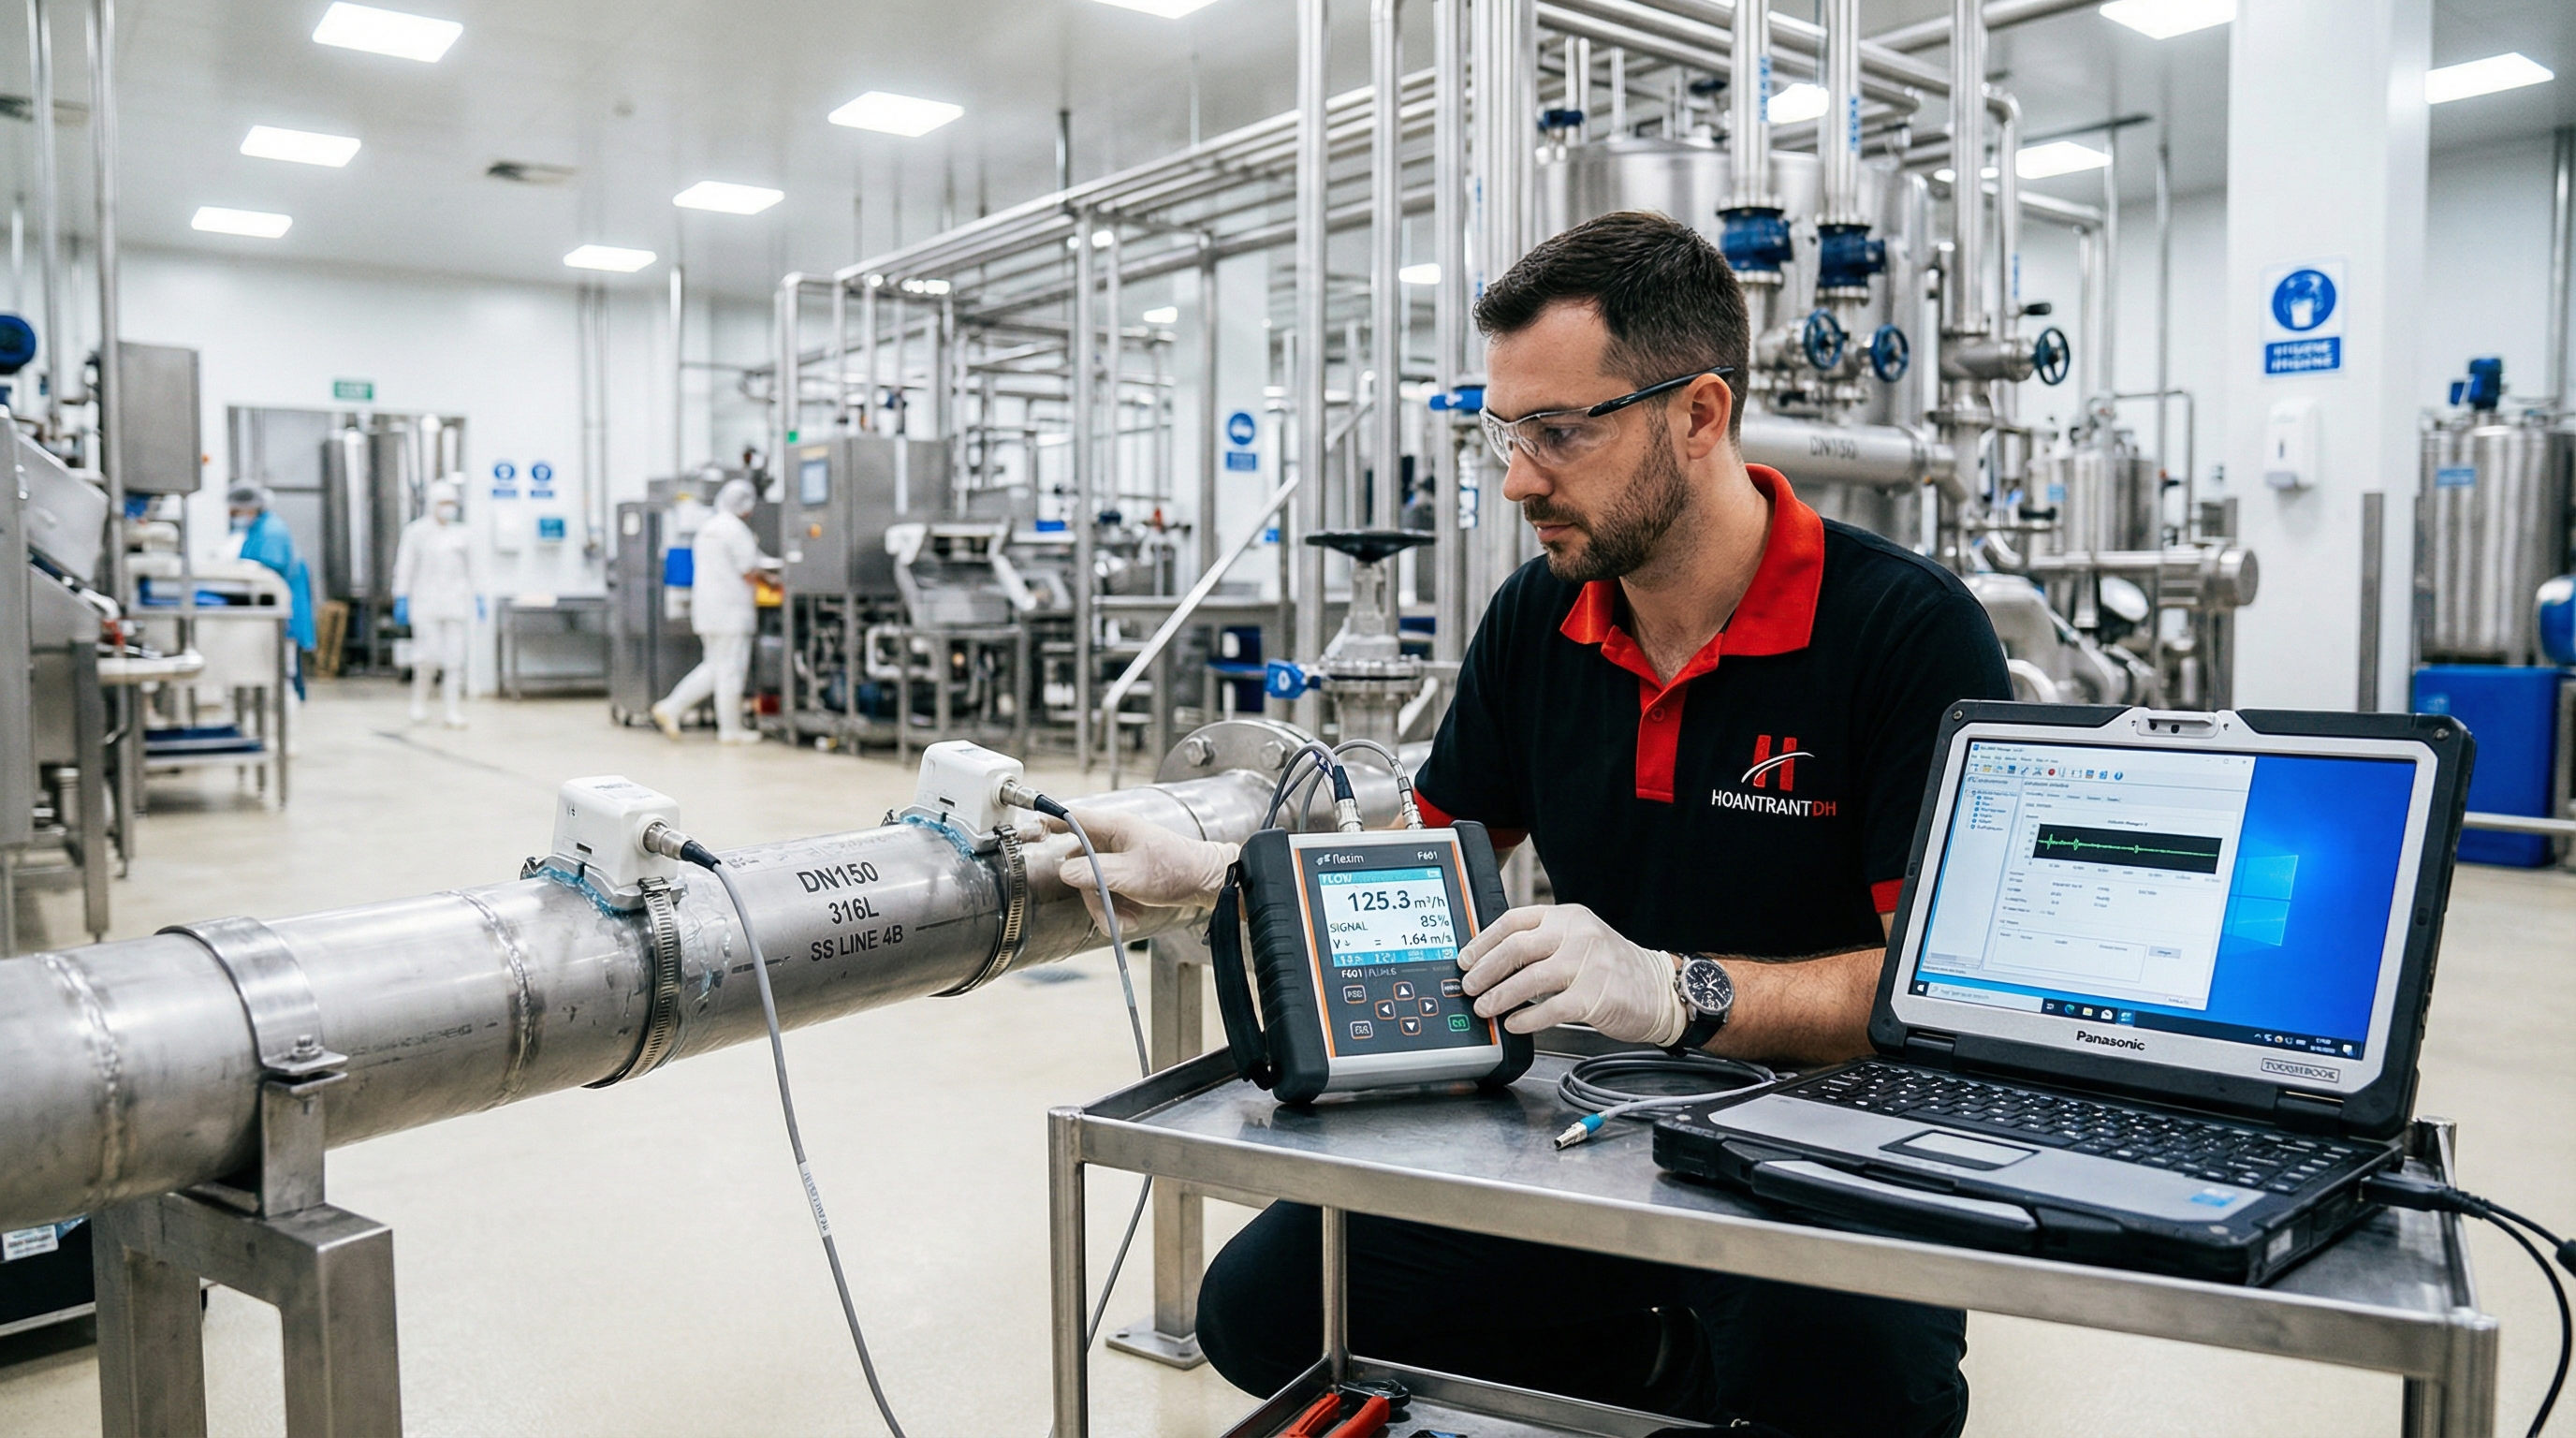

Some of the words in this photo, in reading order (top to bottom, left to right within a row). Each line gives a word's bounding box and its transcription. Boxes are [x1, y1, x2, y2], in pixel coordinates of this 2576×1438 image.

[1711, 789, 1837, 816] HOANTRANTDH
[1417, 851, 1438, 860] F601
[796, 861, 879, 893] DN150
[1322, 873, 1353, 884] FLOW
[828, 896, 880, 925] 316L
[1348, 890, 1411, 912] 125.3
[1330, 921, 1368, 932] SIGNAL
[1421, 915, 1450, 927] 85%
[811, 939, 835, 961] SS
[840, 930, 879, 956] LINE
[883, 924, 904, 946] 4B
[1401, 933, 1428, 946] 1.64
[2076, 1030, 2145, 1051] Panasonic
